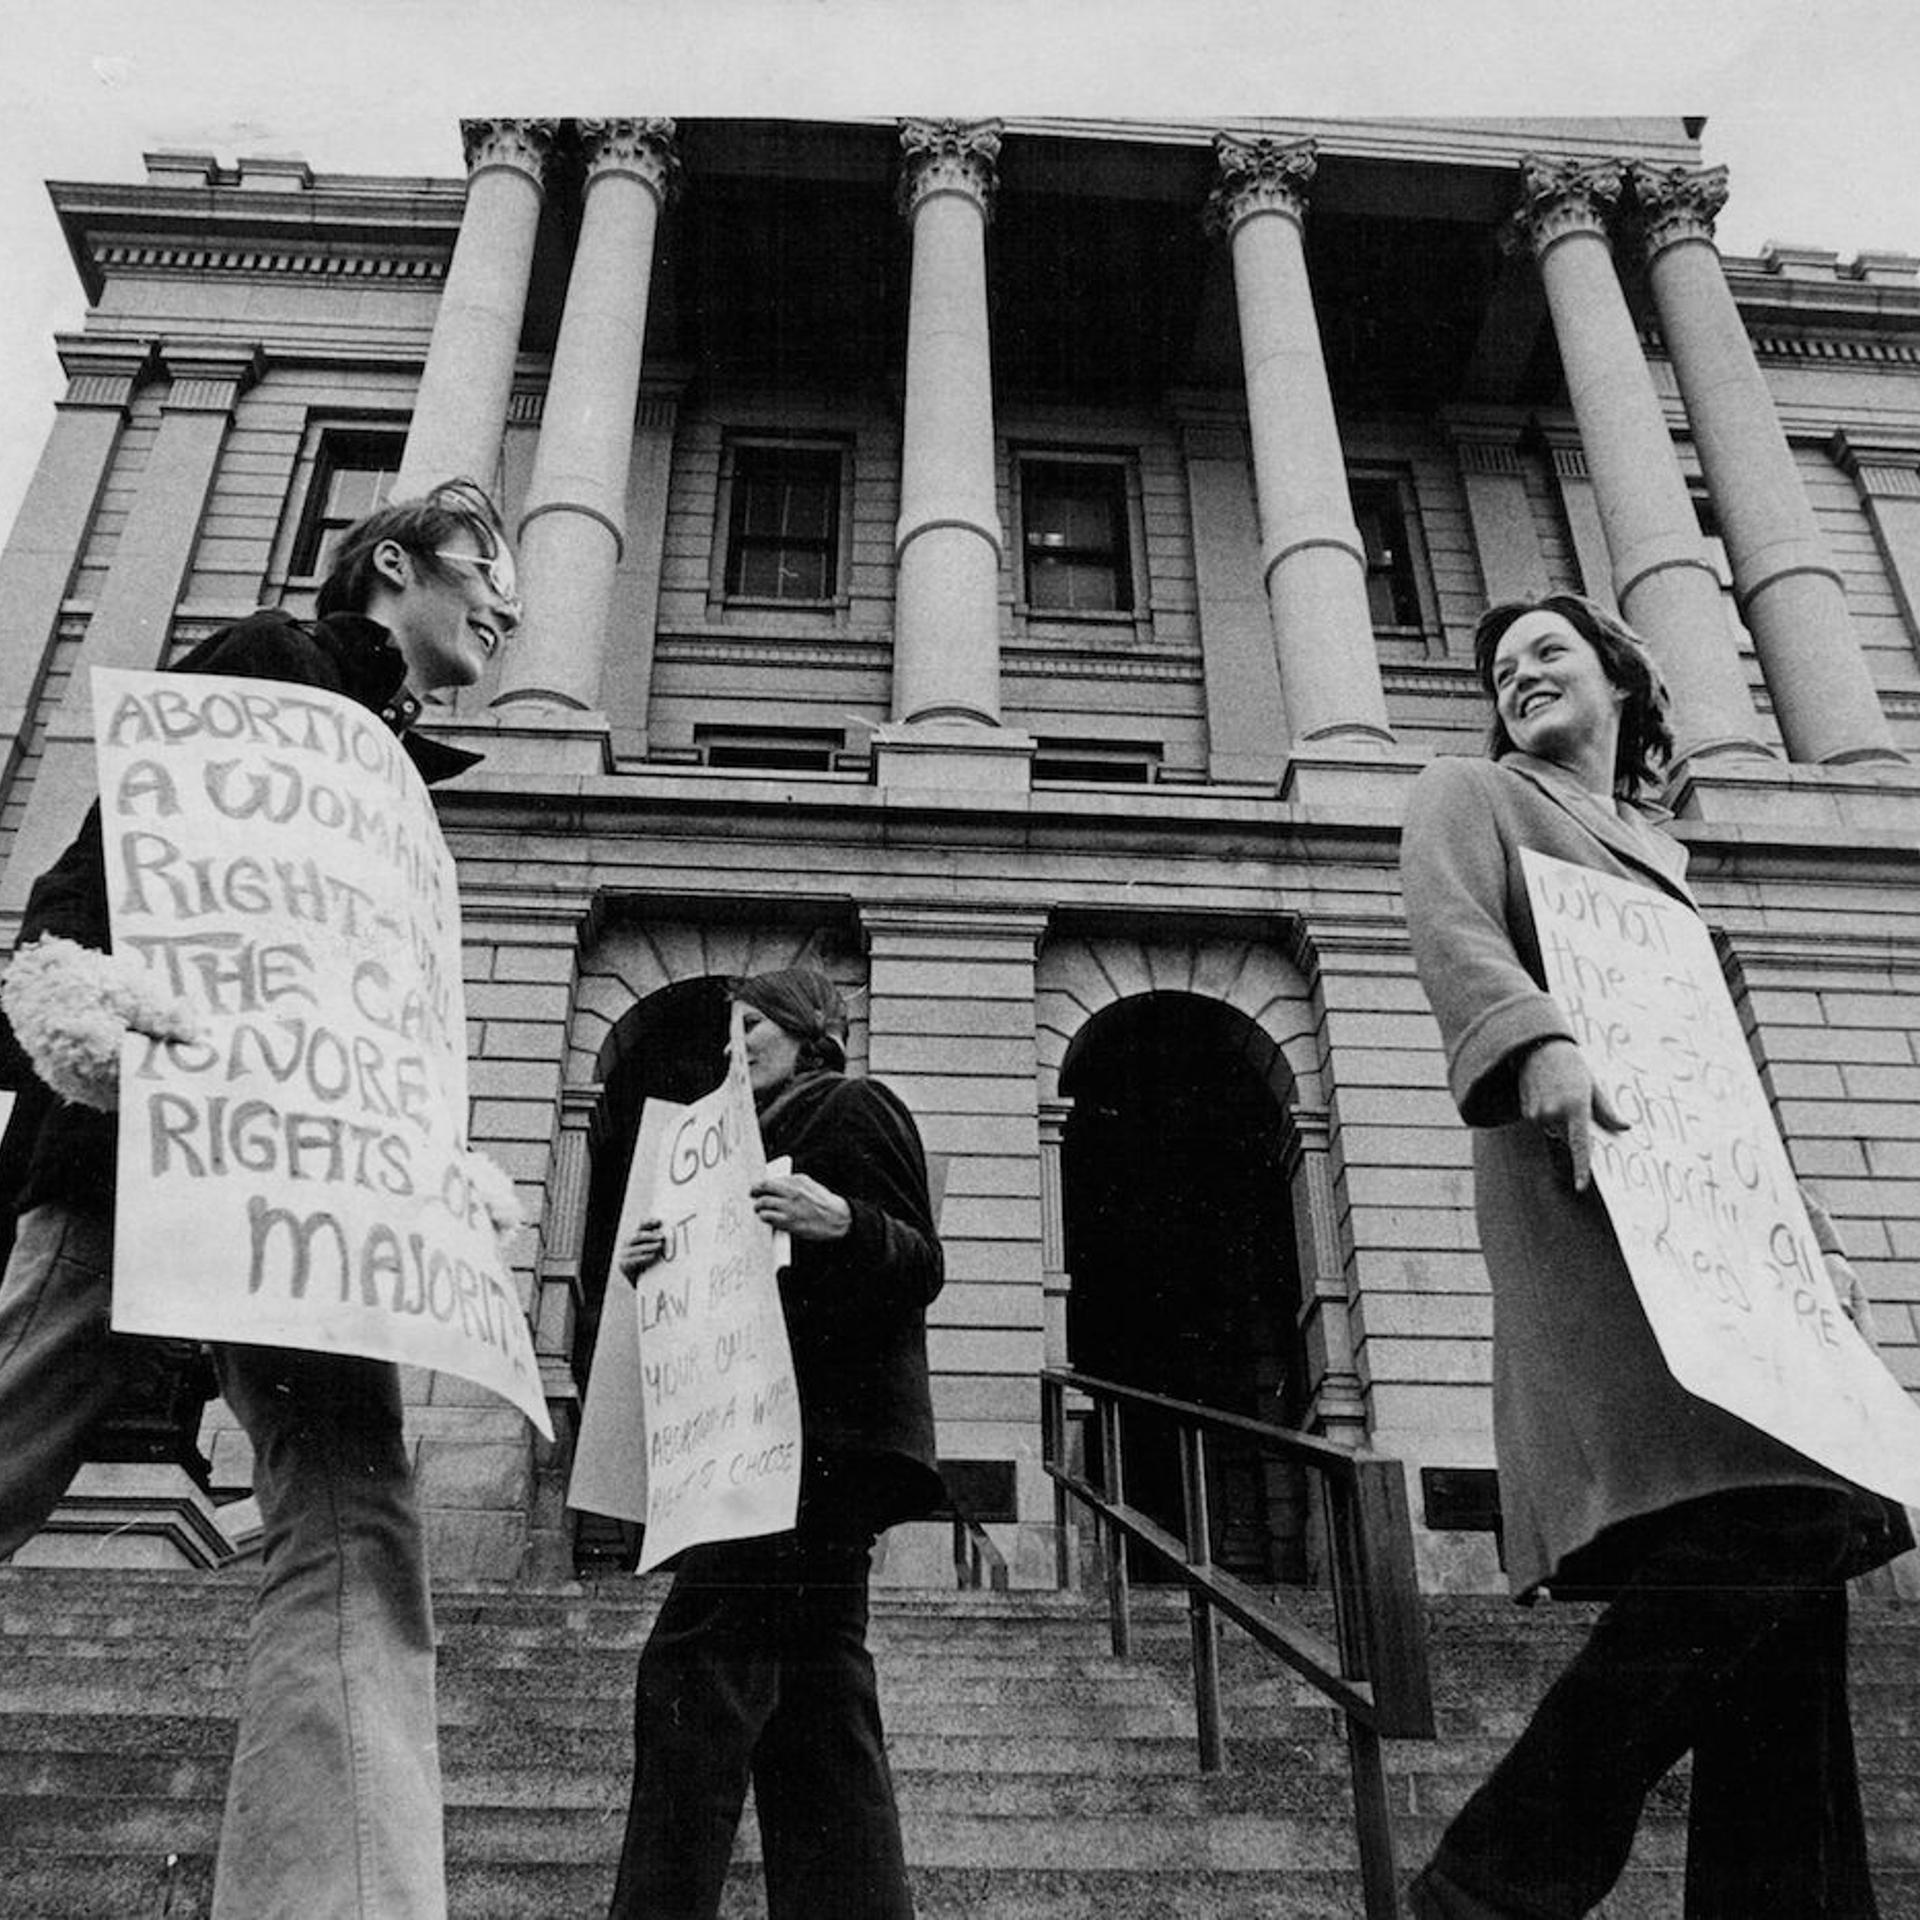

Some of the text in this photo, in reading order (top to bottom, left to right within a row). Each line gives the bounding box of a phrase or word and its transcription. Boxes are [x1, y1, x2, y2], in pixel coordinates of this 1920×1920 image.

[117, 759, 182, 817] A
[119, 932, 318, 1014] THE
[642, 1277, 691, 1335] LAW
